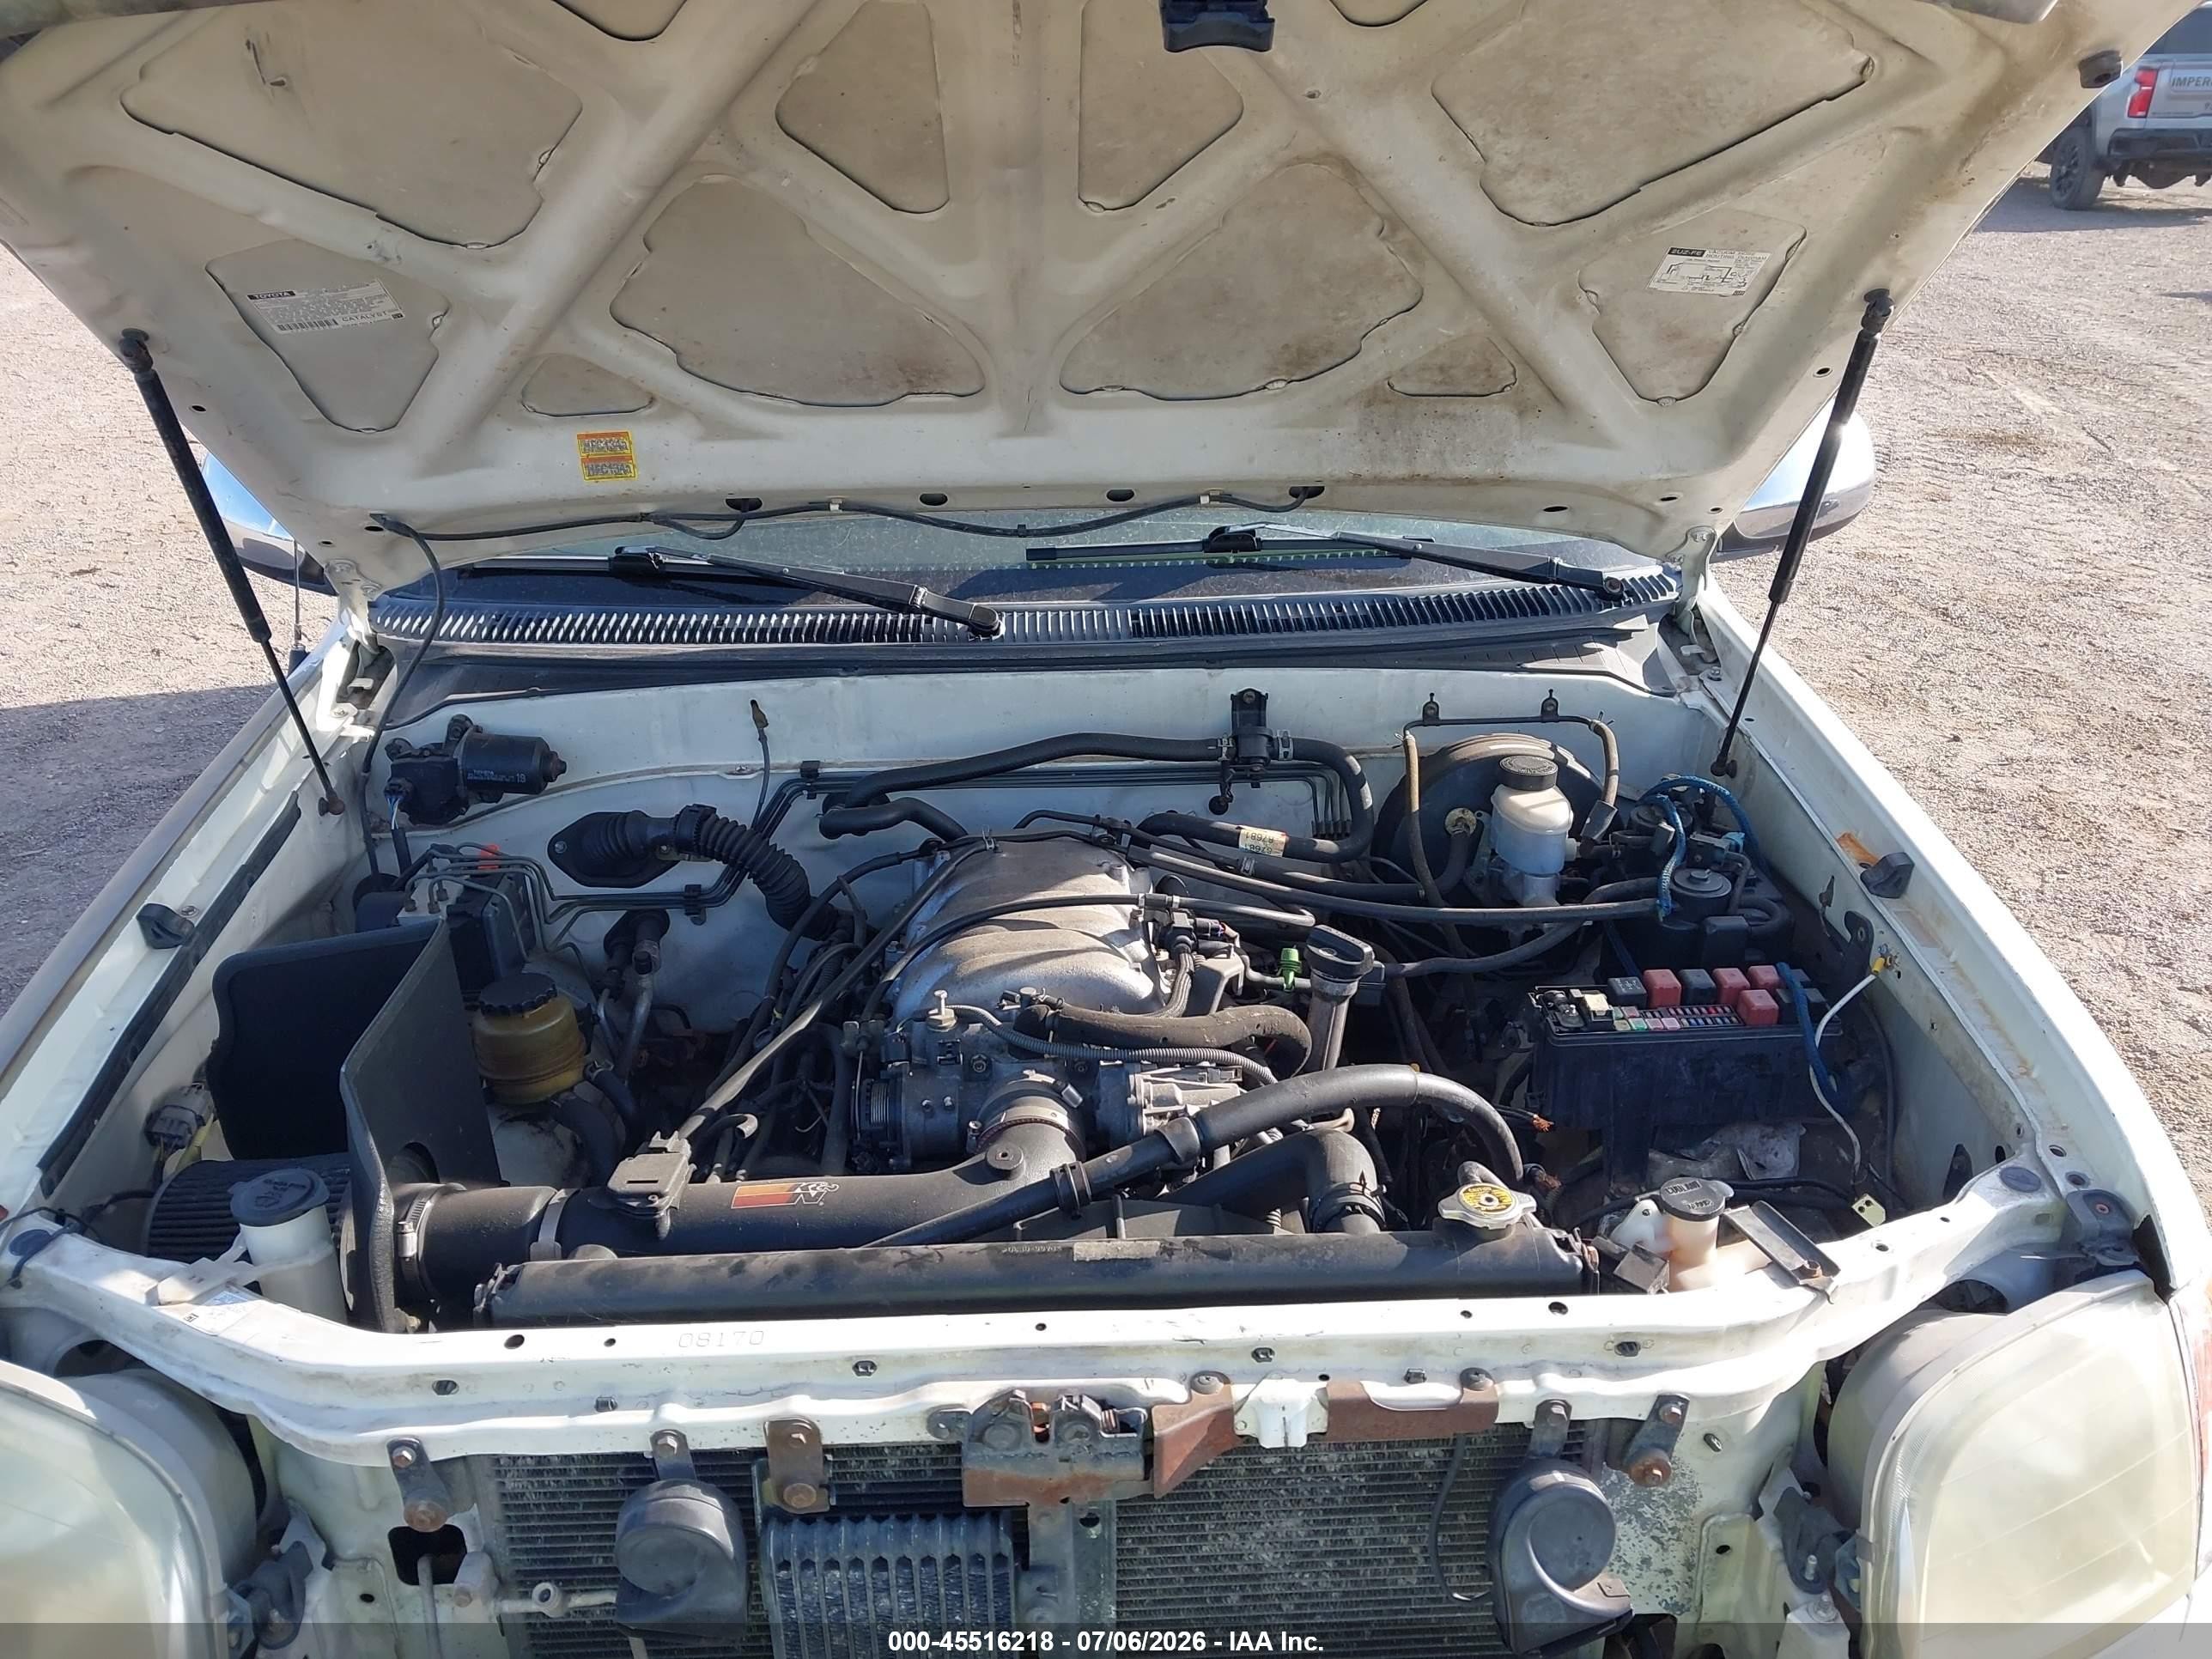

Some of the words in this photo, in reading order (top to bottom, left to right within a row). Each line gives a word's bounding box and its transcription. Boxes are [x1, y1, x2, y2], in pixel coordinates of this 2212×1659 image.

[2172, 76, 2212, 87] IMPER
[253, 291, 290, 300] TOYOTA
[342, 310, 387, 322] CATALYST
[678, 1330, 764, 1348] 08170
